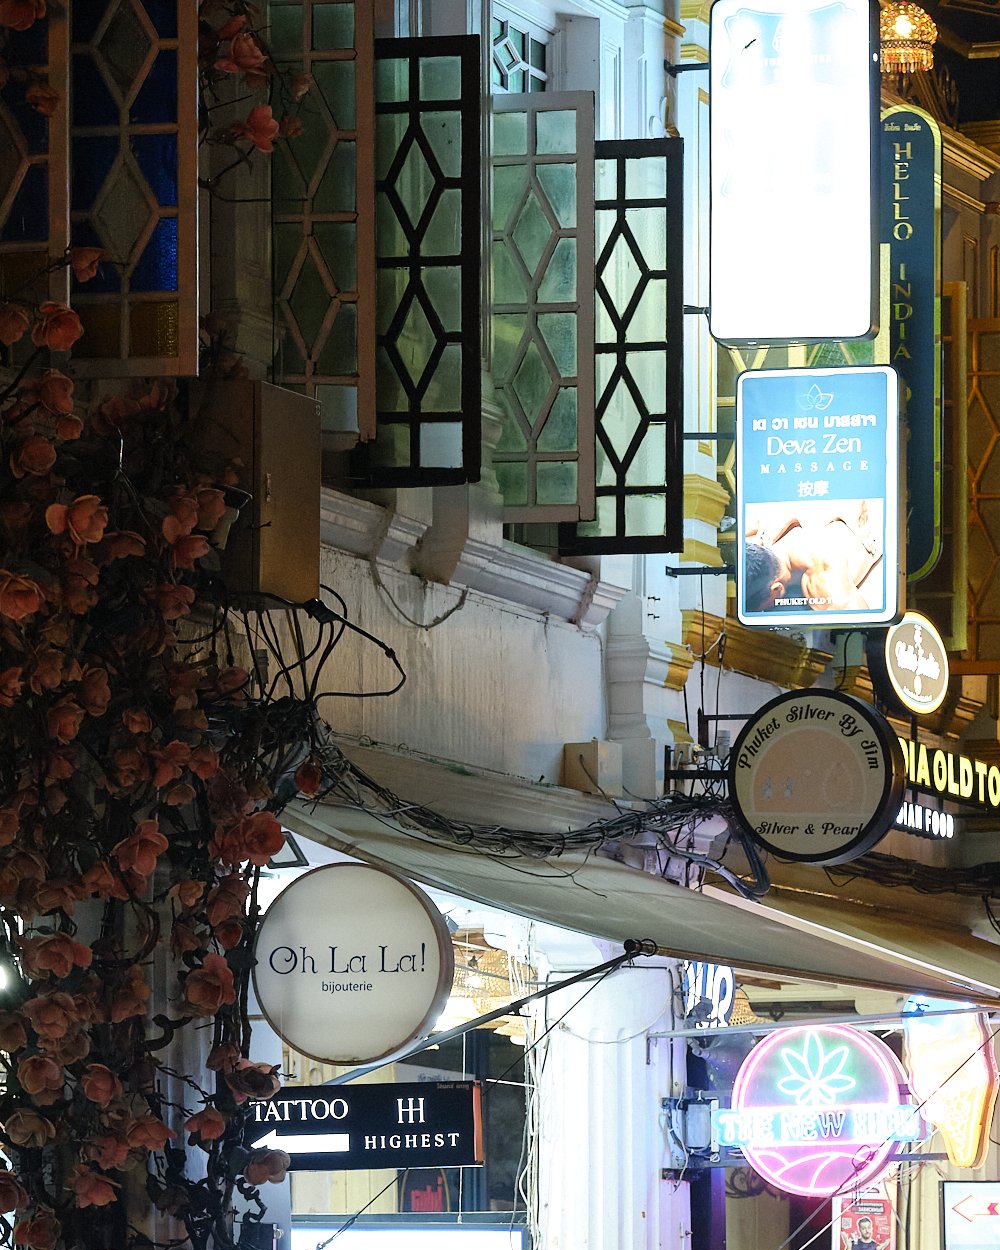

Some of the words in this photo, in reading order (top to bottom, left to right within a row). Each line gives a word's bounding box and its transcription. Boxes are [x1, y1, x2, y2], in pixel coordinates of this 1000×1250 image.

[893, 142, 913, 240] HELLO
[894, 263, 913, 360] INDIA
[767, 436, 817, 456] Deva
[822, 433, 862, 454] Zen
[760, 460, 869, 474] MASSAGE
[738, 717, 781, 770] Phuket
[785, 704, 835, 723] Silver
[838, 713, 863, 737] By
[932, 749, 974, 798] OLD
[754, 821, 800, 835] Silver
[804, 823, 815, 835] &
[925, 808, 954, 839] FOOD
[269, 946, 318, 975] Oh
[328, 946, 367, 974] La
[378, 942, 426, 973] La!
[321, 981, 373, 994] bijouterie
[248, 1098, 349, 1122] TATTOO
[364, 1132, 460, 1150] HIGHEST
